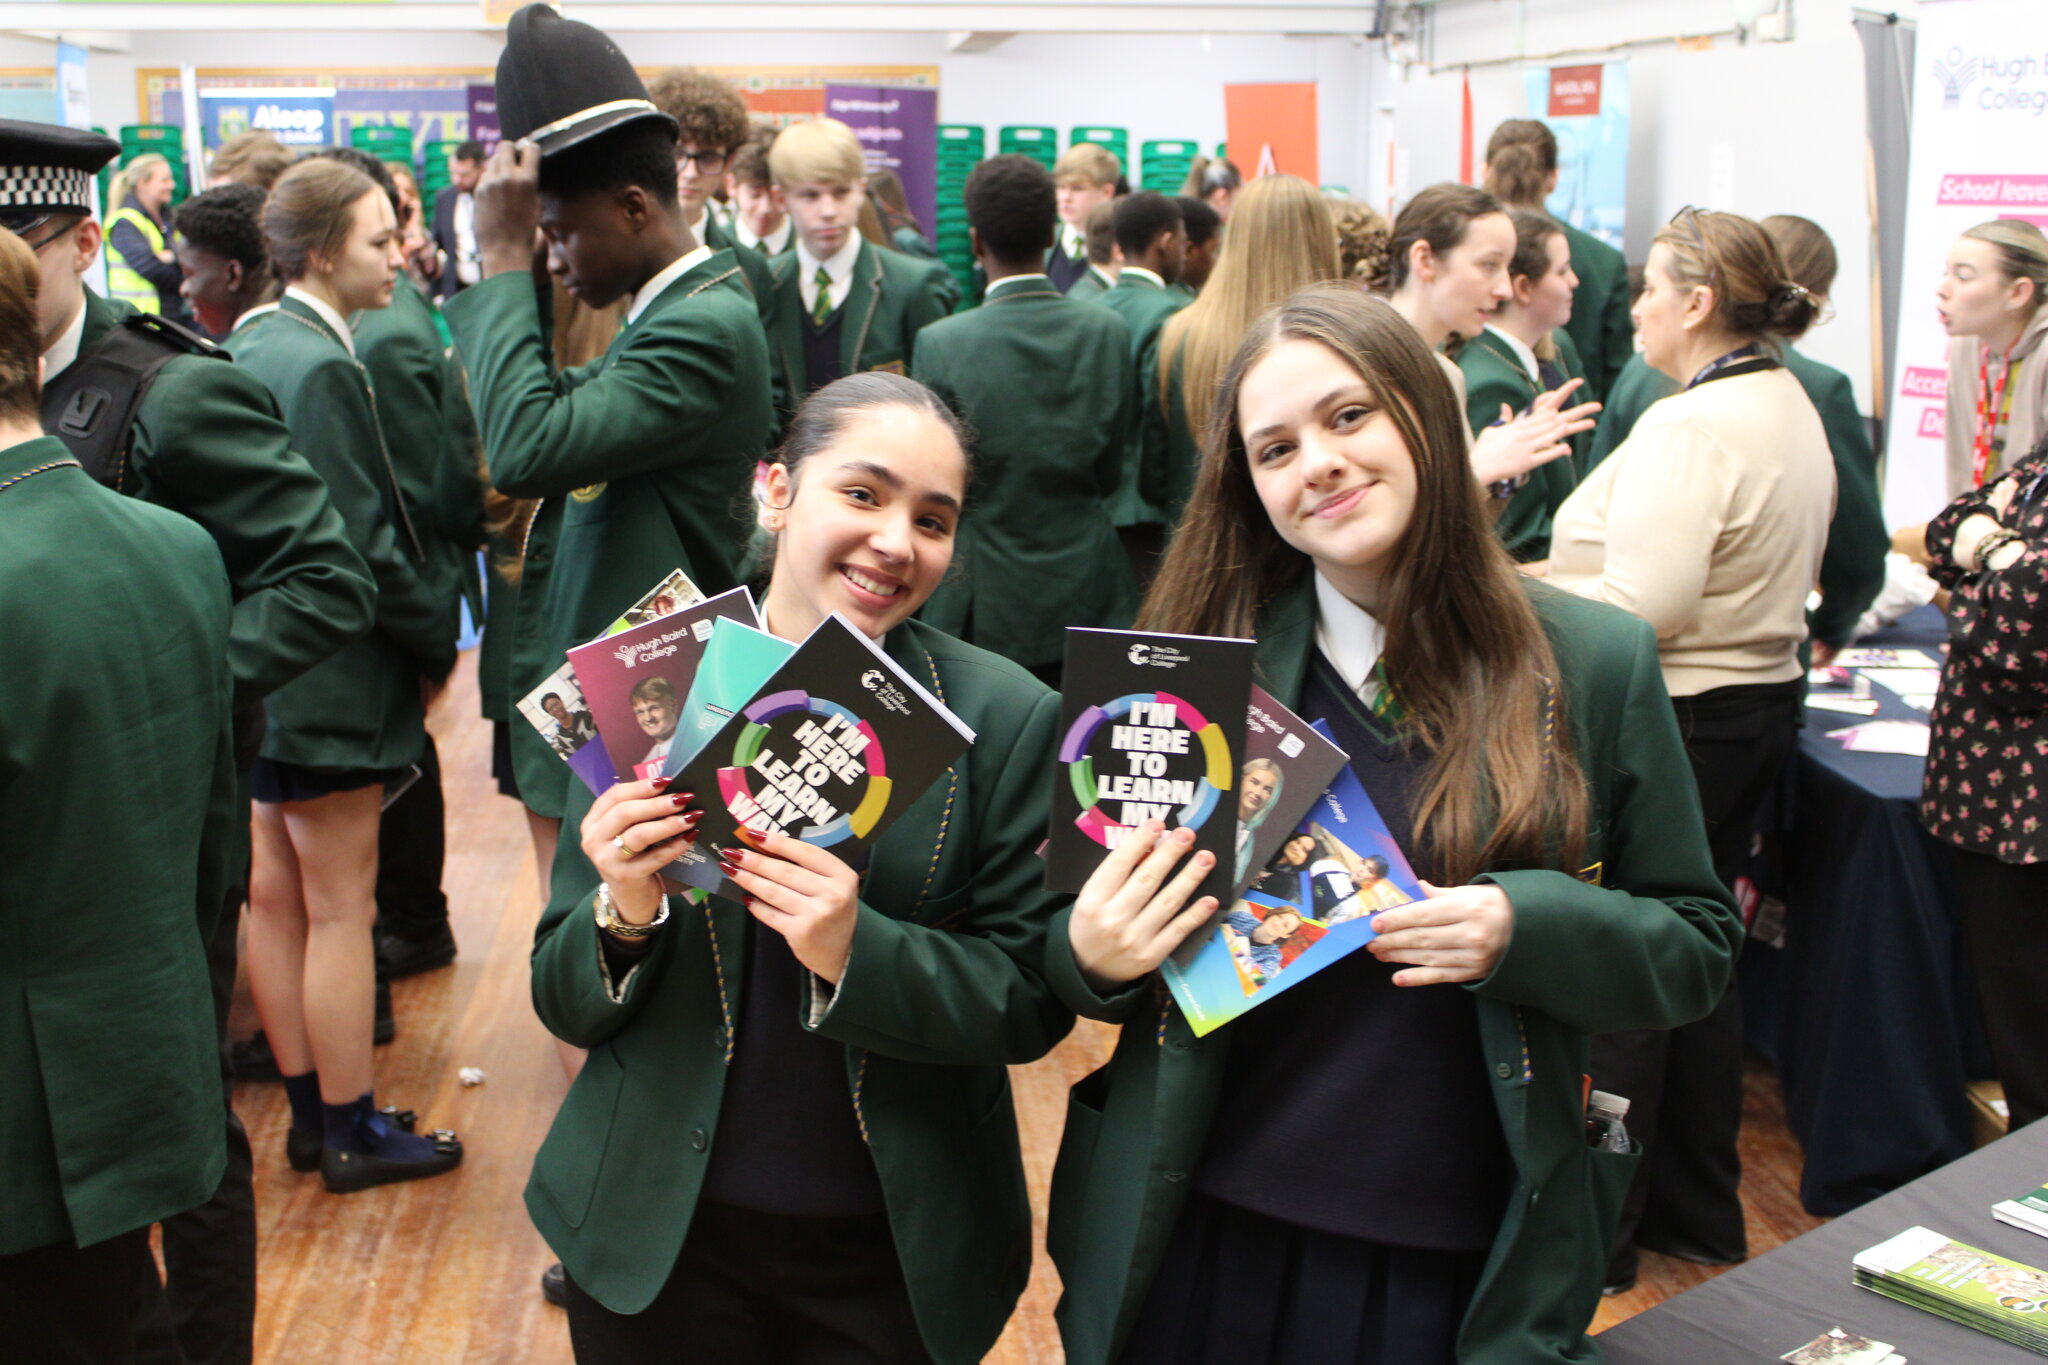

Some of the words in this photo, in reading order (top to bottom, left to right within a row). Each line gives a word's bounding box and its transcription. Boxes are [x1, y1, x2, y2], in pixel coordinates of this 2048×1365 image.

[1982, 55, 2037, 85] Hugh
[1978, 86, 2048, 116] Colleg
[1940, 177, 2000, 202] School
[635, 637, 662, 653] Hugh
[661, 626, 688, 644] Baird
[639, 644, 678, 662] College
[1129, 701, 1177, 727] I'M
[821, 712, 872, 757] I'M
[1111, 725, 1190, 754] HERE
[792, 719, 866, 785] HERE
[1127, 751, 1168, 777] TO
[791, 748, 831, 787] TO
[751, 748, 838, 827] LEARN
[1097, 775, 1194, 805] LEARN
[753, 784, 805, 827] MY
